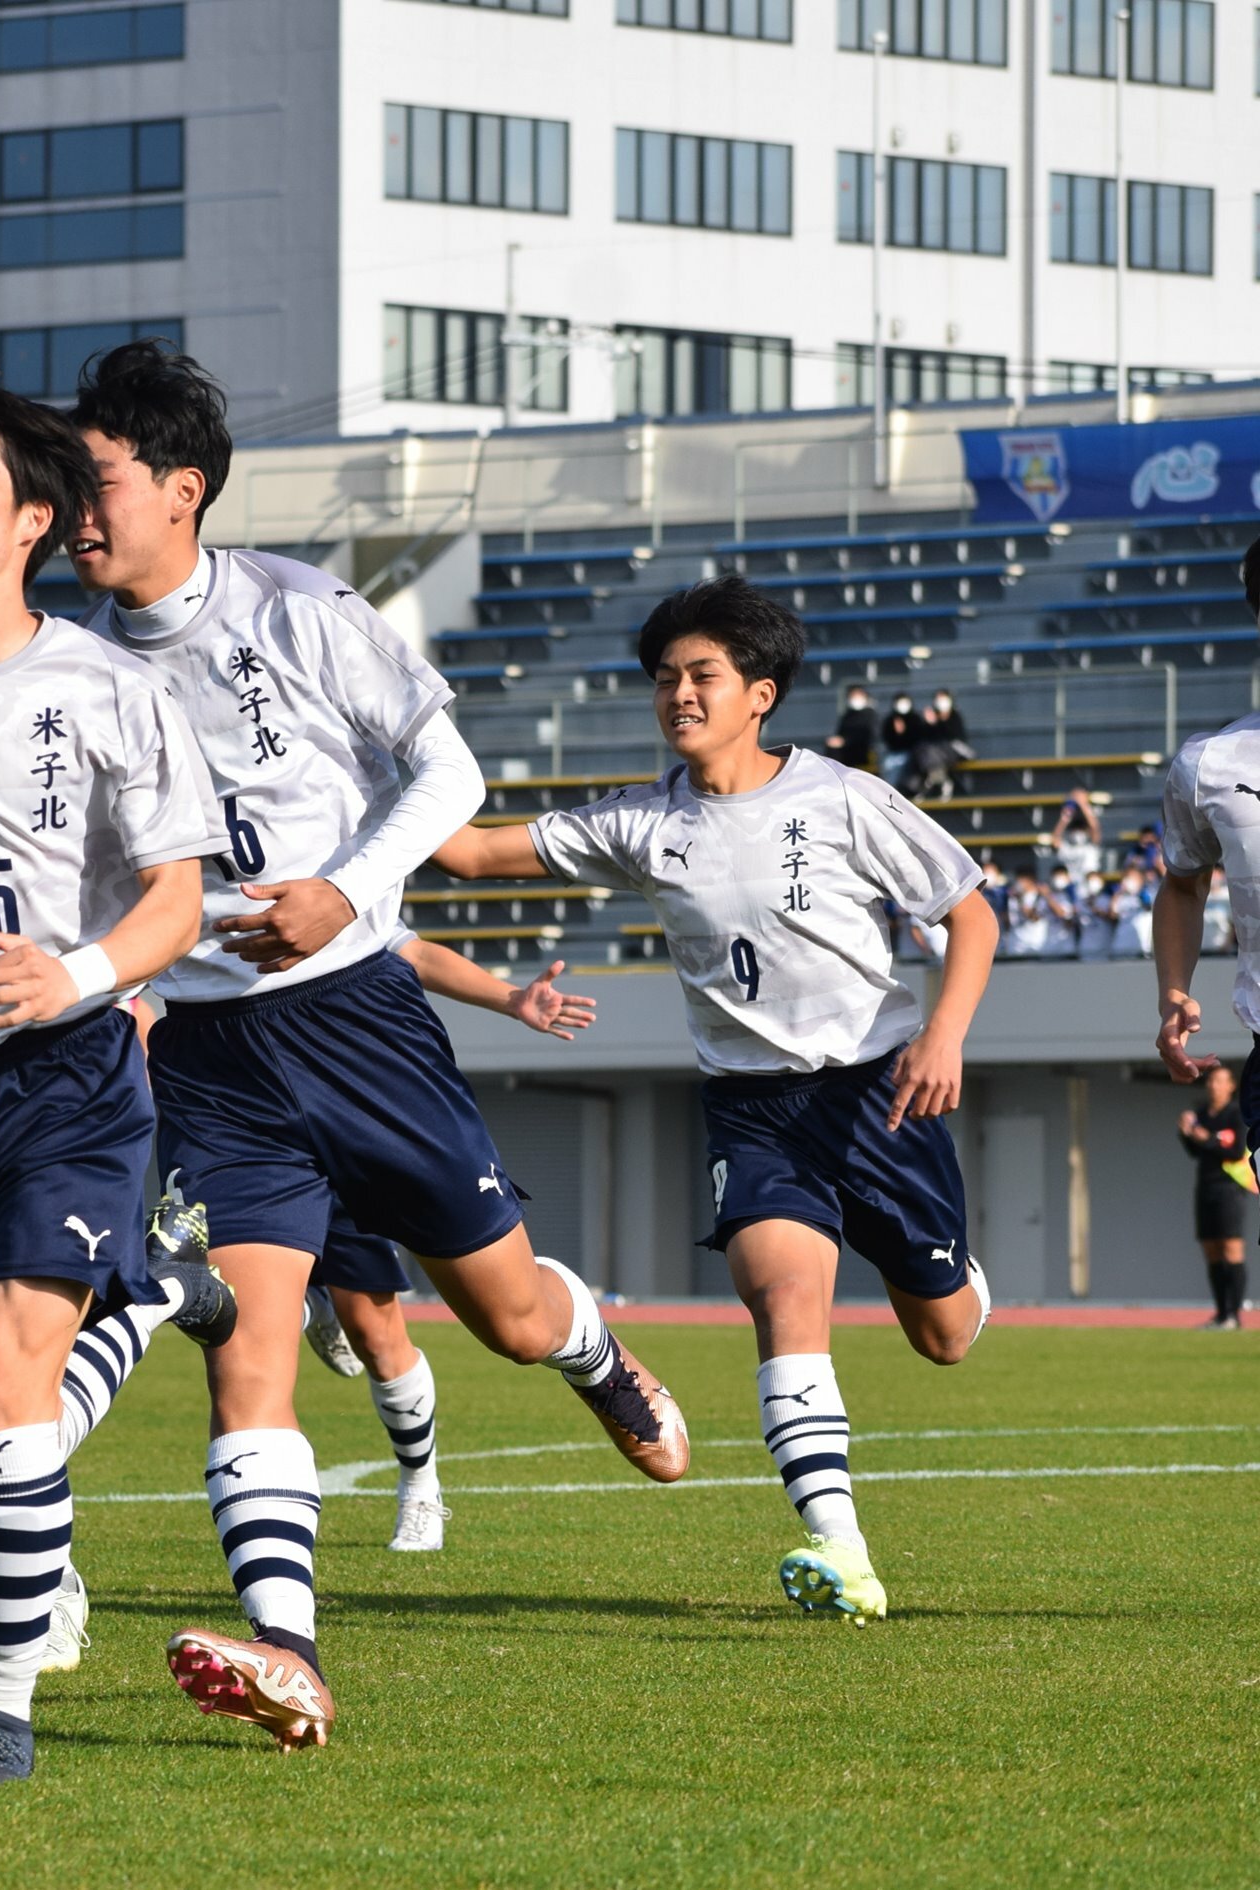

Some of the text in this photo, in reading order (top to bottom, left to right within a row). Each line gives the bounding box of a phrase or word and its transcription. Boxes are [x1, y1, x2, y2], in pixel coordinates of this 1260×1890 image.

[230, 646, 288, 765] 米子北
[29, 707, 67, 833] 米子北
[781, 818, 811, 913] 米子北
[731, 938, 760, 1001] 9
